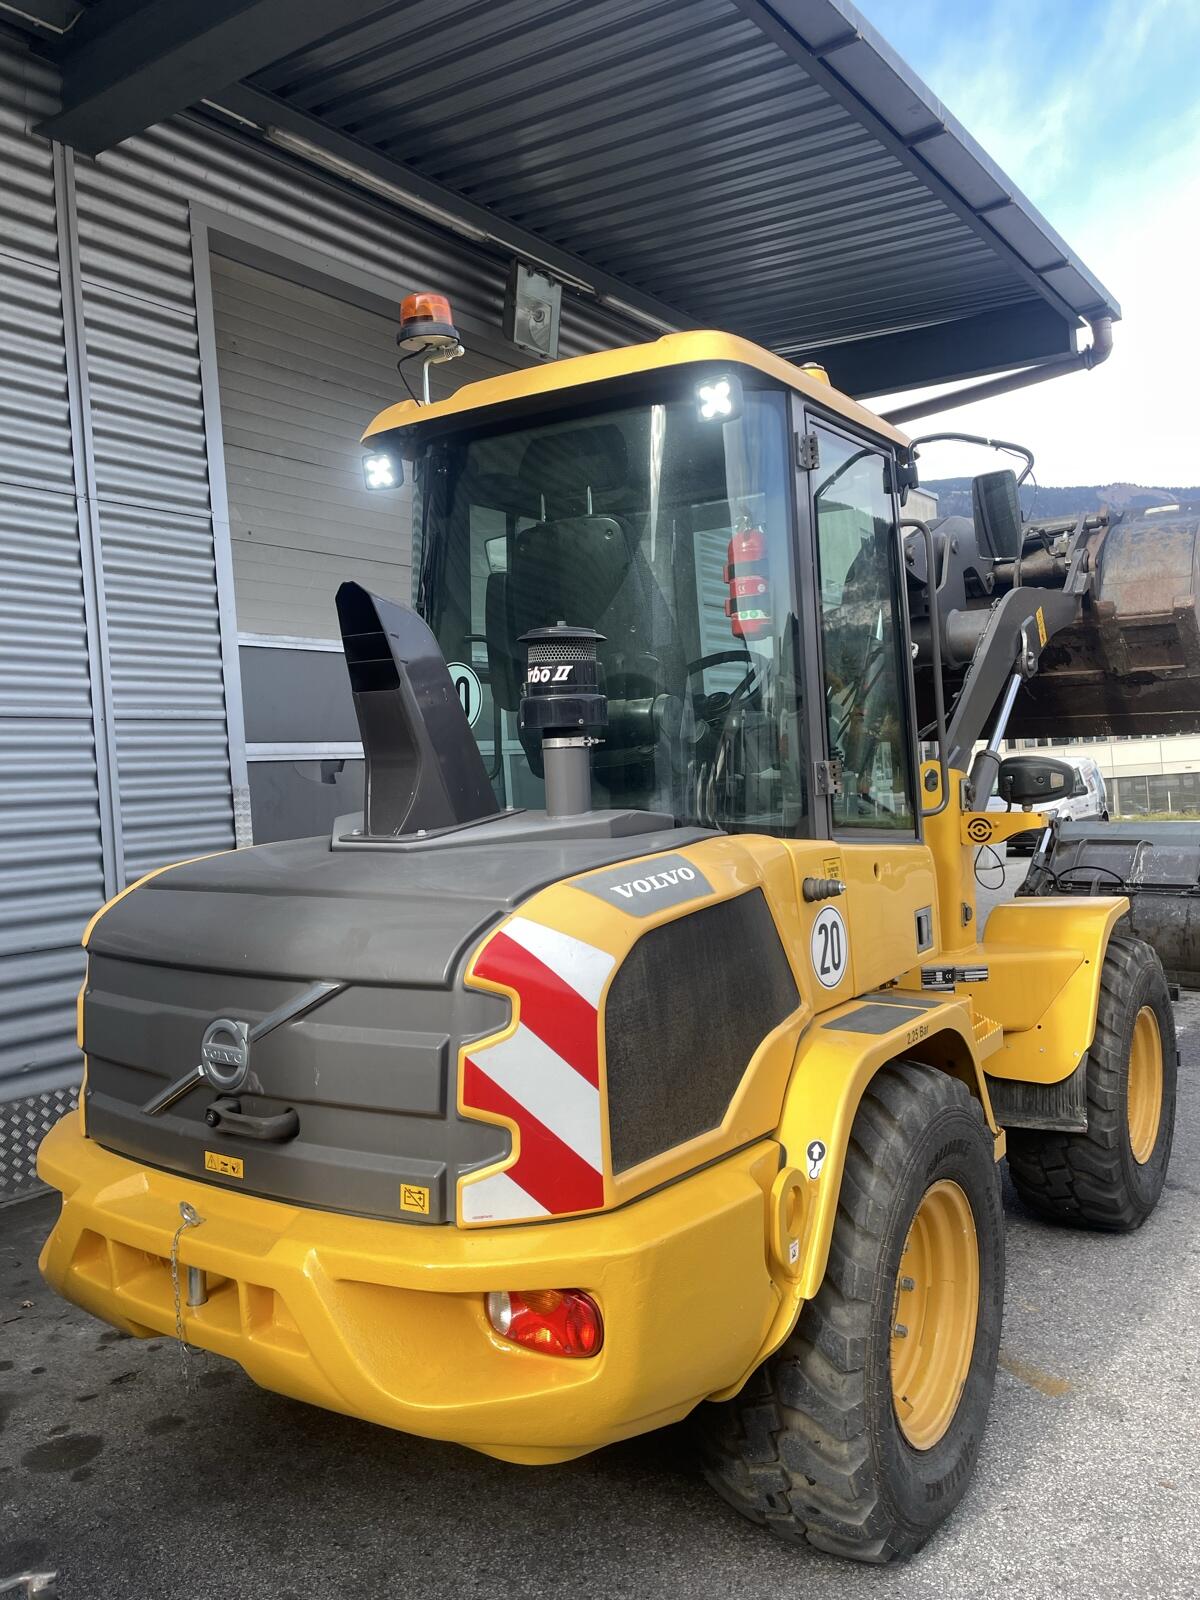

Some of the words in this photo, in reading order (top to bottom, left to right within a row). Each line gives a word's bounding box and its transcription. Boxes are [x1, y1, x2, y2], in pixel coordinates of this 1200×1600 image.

[528, 666, 551, 683] rbo
[552, 665, 573, 681] II
[610, 867, 695, 898] VOLVO
[818, 920, 841, 975] 20
[203, 1047, 242, 1063] VOLVO
